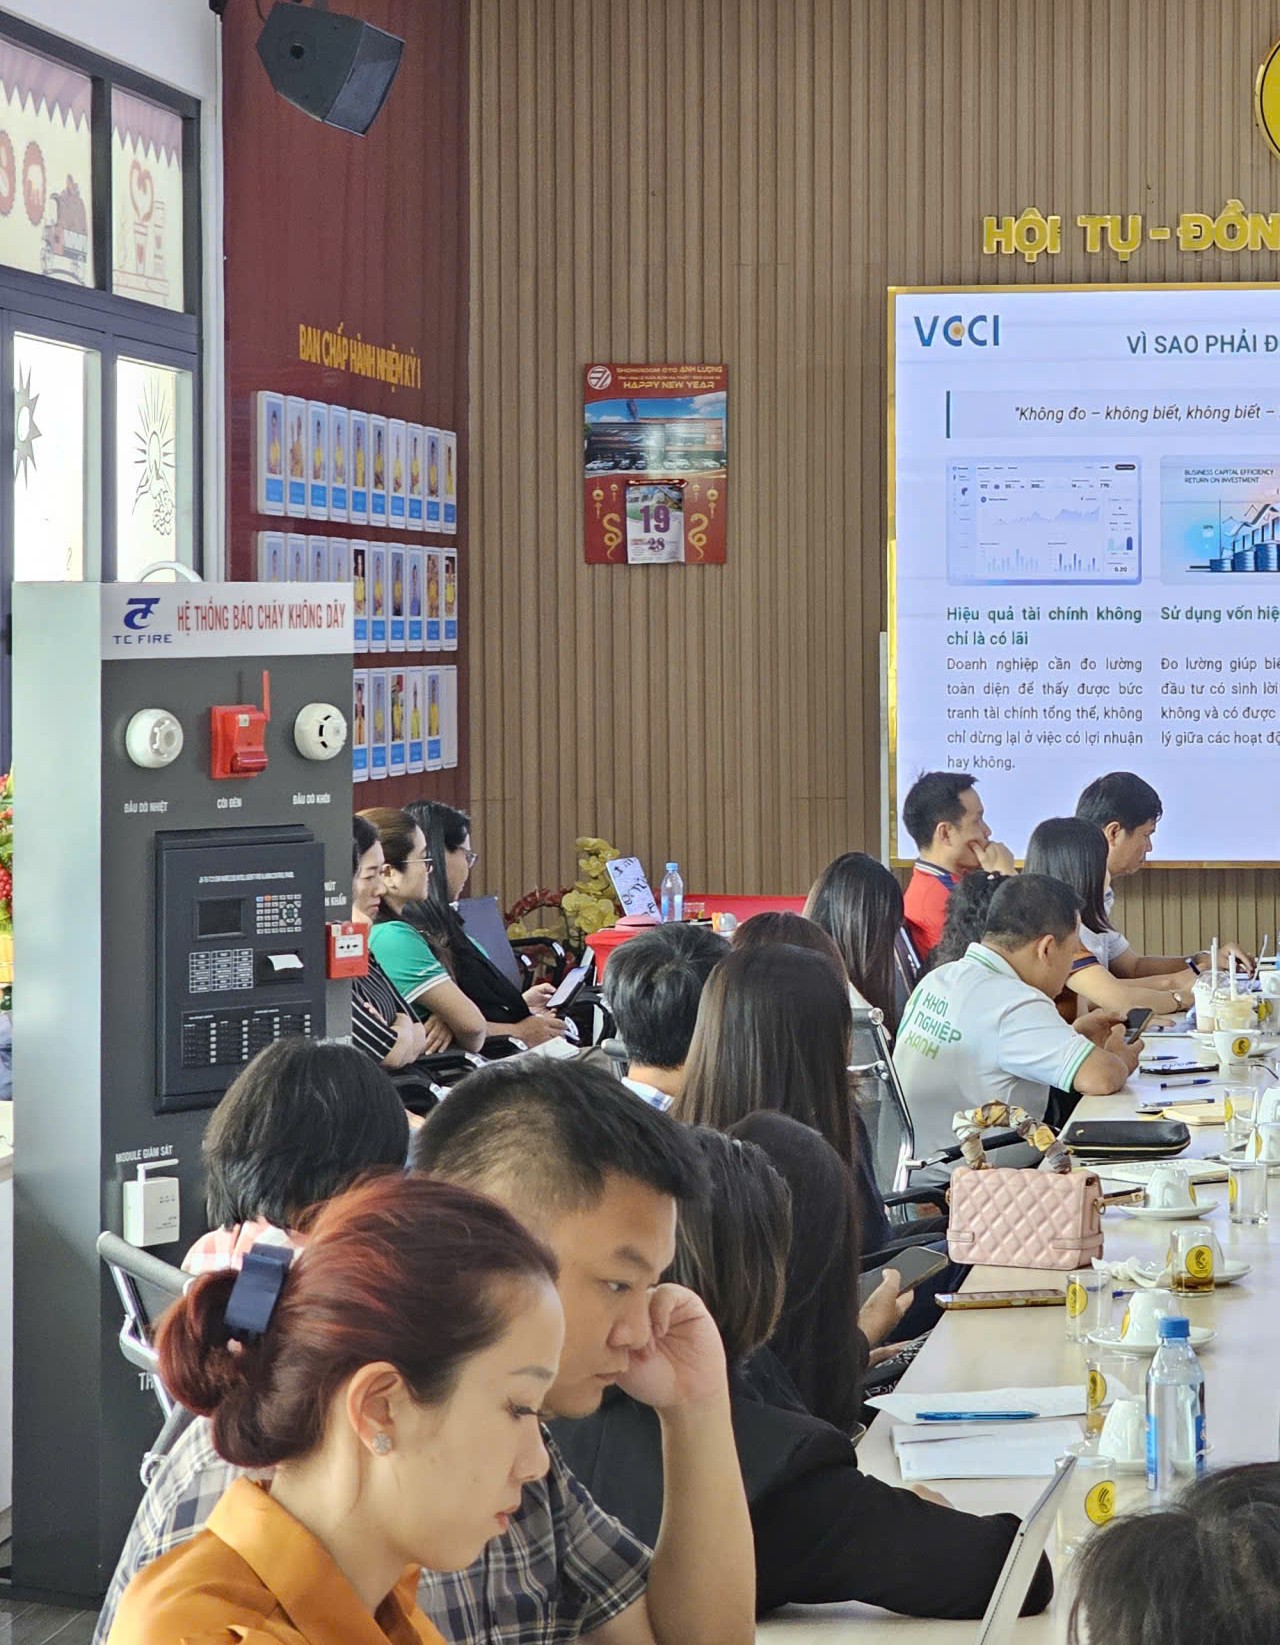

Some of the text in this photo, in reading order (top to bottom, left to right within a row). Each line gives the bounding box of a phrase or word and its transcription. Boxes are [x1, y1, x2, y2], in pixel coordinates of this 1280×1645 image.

[983, 207, 1061, 264] HỘI
[1077, 212, 1142, 261] TỤ
[914, 314, 1000, 347] VCCI
[1127, 331, 1146, 354] VÌ
[1154, 335, 1198, 354] SAO
[1206, 328, 1257, 353] PHẢI
[299, 323, 321, 363] BAN
[349, 334, 376, 378] HÀNH
[376, 343, 403, 392] NHIỆM
[623, 381, 715, 389] HAPPY NEW YEAR
[1015, 407, 1064, 424] "Không
[1068, 406, 1086, 419] đo
[1105, 405, 1148, 423] không
[1153, 404, 1181, 422] biết,
[1186, 404, 1230, 422] không
[1234, 403, 1260, 419] biết
[639, 505, 670, 534] 19
[648, 537, 665, 551] 28
[177, 596, 346, 637] HỆ THỐNG BÁO CHÁY KHÔNG DÂY
[947, 606, 1141, 624] Hiệu quả tài chính không
[1161, 605, 1181, 620] Sử
[1185, 606, 1221, 623] dụng
[1226, 605, 1252, 620] vốn
[113, 633, 173, 645] TC FIRE
[947, 630, 1028, 645] chỉ là có lãi
[947, 656, 1142, 673] Doanh nghiệp cần đo lường
[1161, 658, 1178, 669] Đo
[1186, 657, 1222, 673] lường
[1230, 657, 1257, 673] giúp
[1161, 681, 1185, 694] đầu
[1191, 684, 1205, 694] tư
[1210, 682, 1225, 694] có
[1232, 682, 1257, 695] sinh
[1264, 682, 1278, 695] lời
[922, 992, 948, 1018] KHỞI
[913, 1012, 962, 1046] NGHIỆP
[904, 1030, 940, 1060] XANH
[115, 1149, 142, 1164] MODULE
[160, 1143, 174, 1158] SÁT
